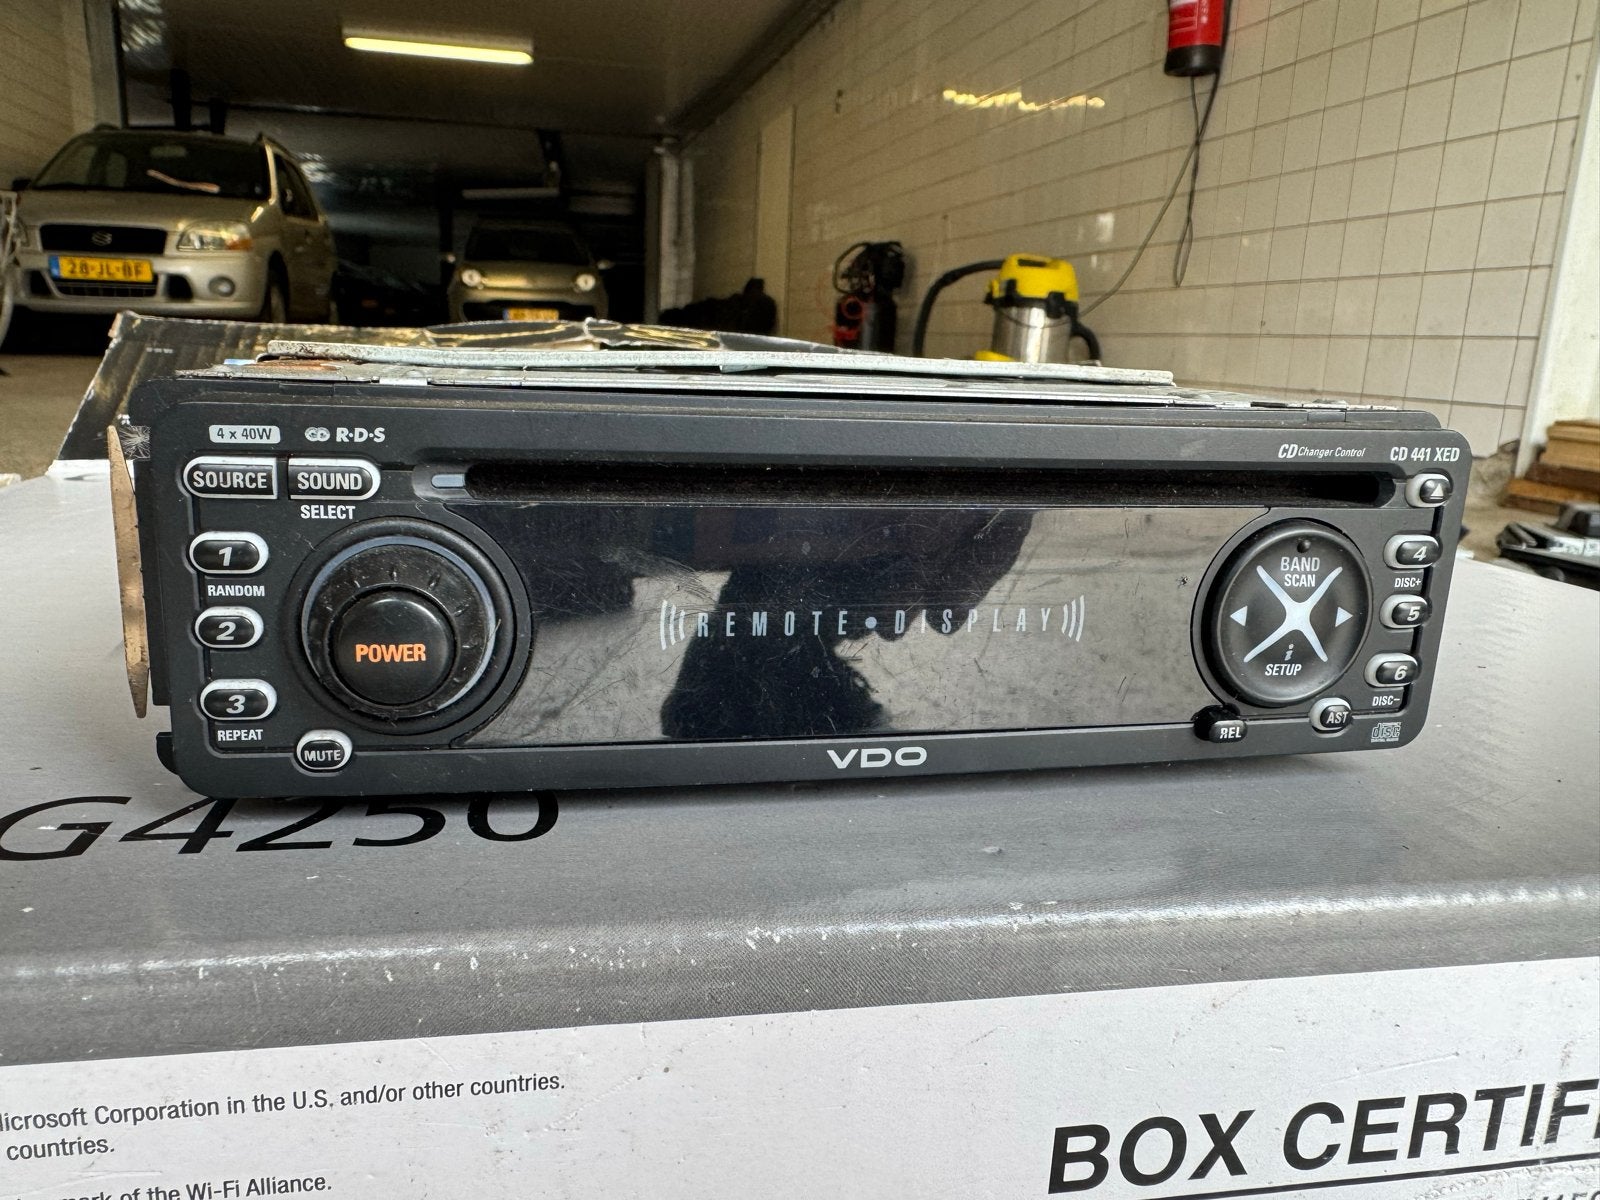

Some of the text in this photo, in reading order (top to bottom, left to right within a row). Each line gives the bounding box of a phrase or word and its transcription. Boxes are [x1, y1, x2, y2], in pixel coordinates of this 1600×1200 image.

[216, 427, 272, 440] 4 x 40W
[1278, 443, 1366, 459] CD Changer Control
[1390, 446, 1460, 462] CD 441 XED
[193, 470, 268, 490] SOURCE
[297, 472, 363, 491] SOUND
[300, 504, 356, 520] SELECT
[218, 546, 233, 567] 1
[1412, 546, 1427, 561] 4
[1280, 556, 1320, 572] BAND
[1284, 573, 1316, 588] SCAN
[1394, 577, 1422, 588] DISC+
[207, 584, 265, 597] RANDOM
[1406, 606, 1420, 622] 5
[697, 607, 1051, 638] REMOTE DISPLAY
[216, 621, 236, 641] 2
[355, 643, 427, 663] POWER
[1264, 663, 1302, 676] SETUP
[1393, 665, 1408, 681] 6
[226, 694, 246, 714] 3
[1325, 710, 1350, 725] AST
[217, 729, 264, 742] REPEAT
[1219, 726, 1242, 740] REL
[304, 750, 342, 762] MUTE
[827, 746, 928, 770] VDO
[0, 1107, 88, 1132] icrosoft
[94, 1099, 219, 1126] Corporation
[227, 1096, 245, 1114] in
[252, 1094, 285, 1112] the
[340, 1084, 406, 1106] and/or
[412, 1080, 464, 1100] other
[470, 1073, 565, 1096] countries.
[1048, 1078, 1600, 1195] BOX CERTIF
[6, 1137, 115, 1161] countries.
[185, 1180, 240, 1200] Wi-Fi
[245, 1176, 332, 1197] Alliance.
